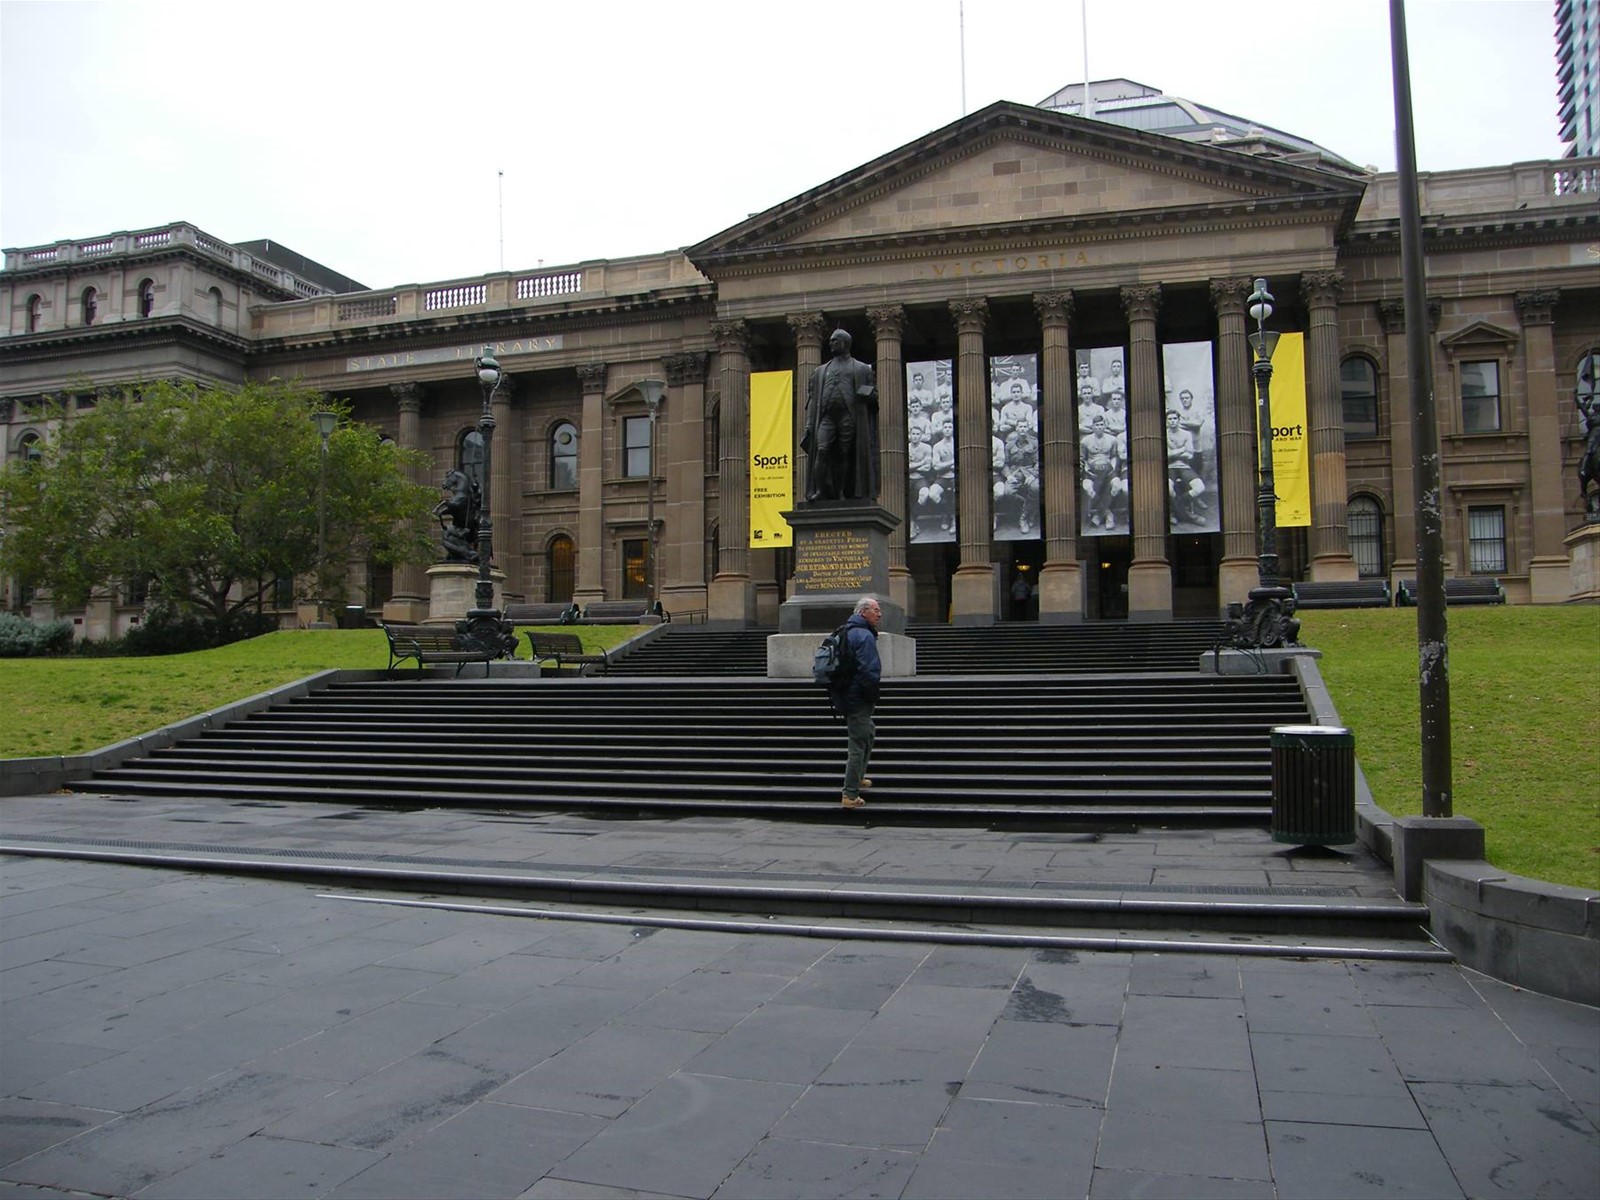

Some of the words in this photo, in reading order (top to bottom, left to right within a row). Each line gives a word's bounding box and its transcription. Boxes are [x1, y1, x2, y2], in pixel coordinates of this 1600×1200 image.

[932, 250, 1089, 277] VICTORIA
[350, 353, 415, 370] STATE
[1271, 424, 1302, 440] port
[753, 454, 788, 470] Sport
